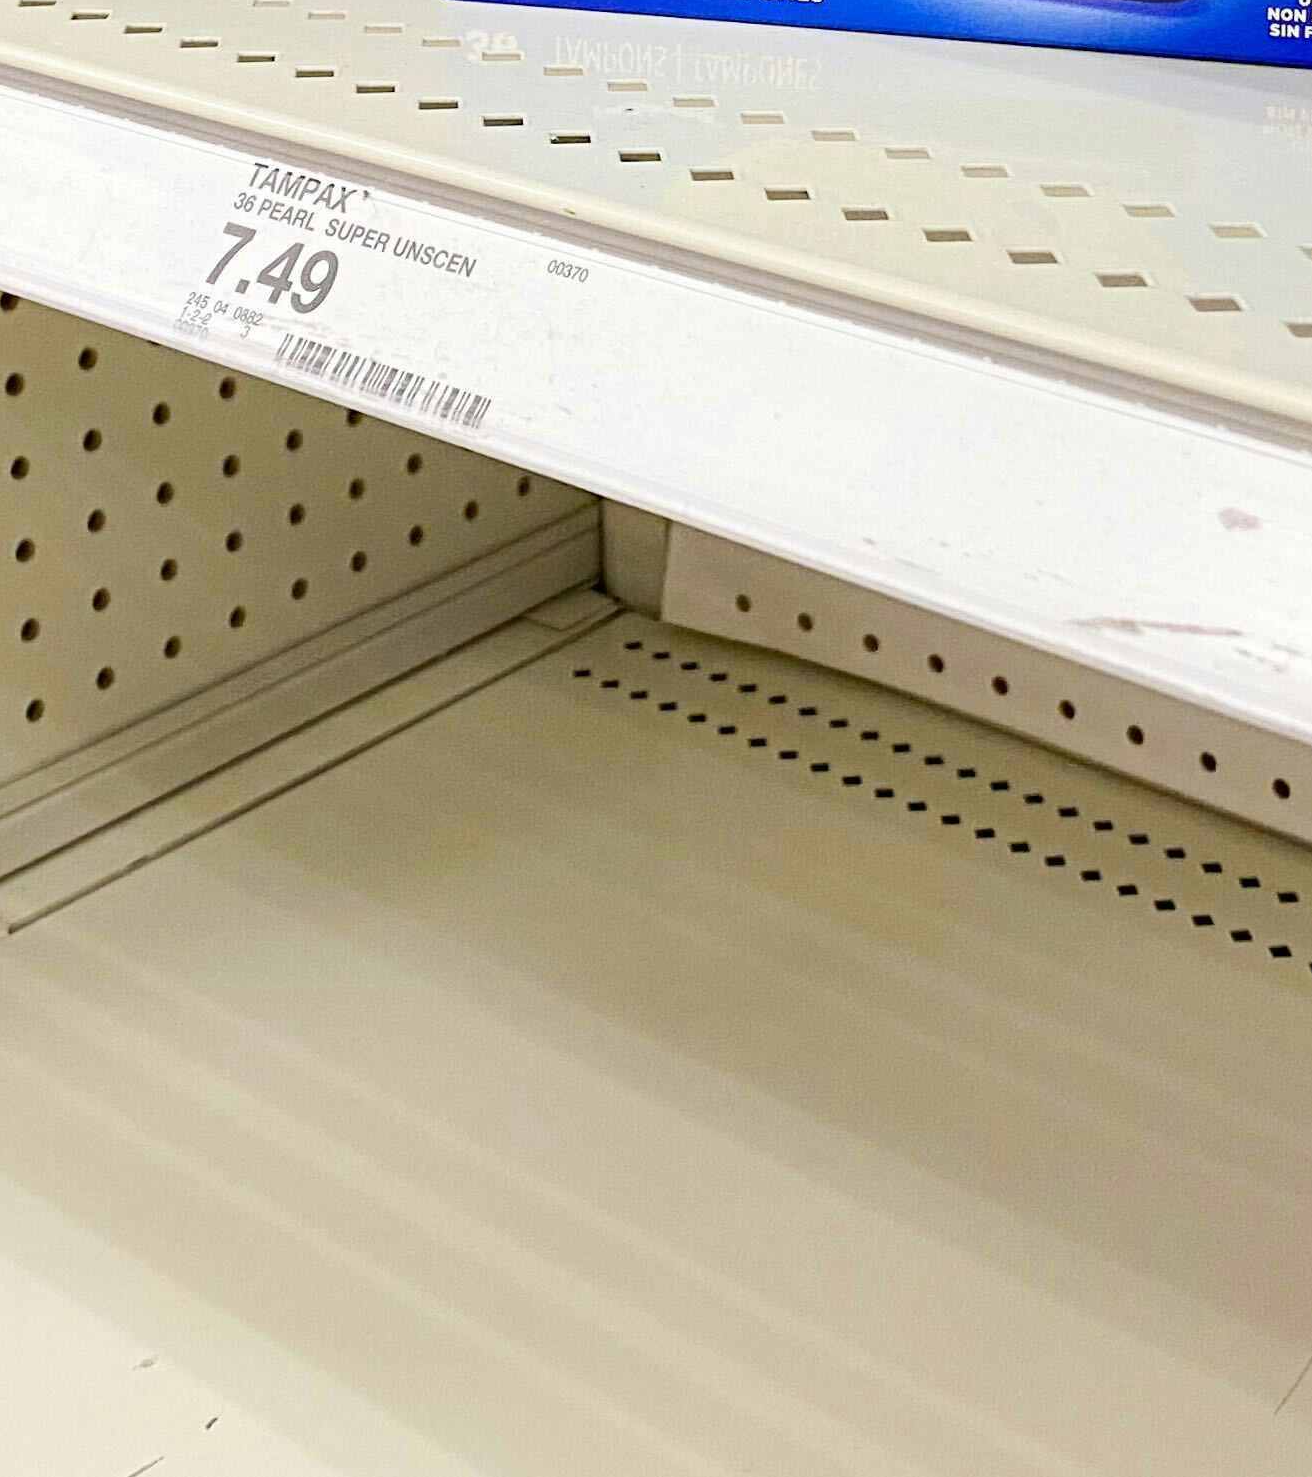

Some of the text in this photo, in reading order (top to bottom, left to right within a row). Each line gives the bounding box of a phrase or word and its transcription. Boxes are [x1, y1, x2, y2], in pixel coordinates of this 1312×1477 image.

[1267, 7, 1308, 23] NON
[1269, 23, 1300, 39] SIN
[233, 191, 478, 279] 36 PEARL SUPER UNSCEN
[205, 221, 340, 315] 7.49
[547, 259, 589, 283] 00370
[186, 291, 264, 327] 245 04 0882
